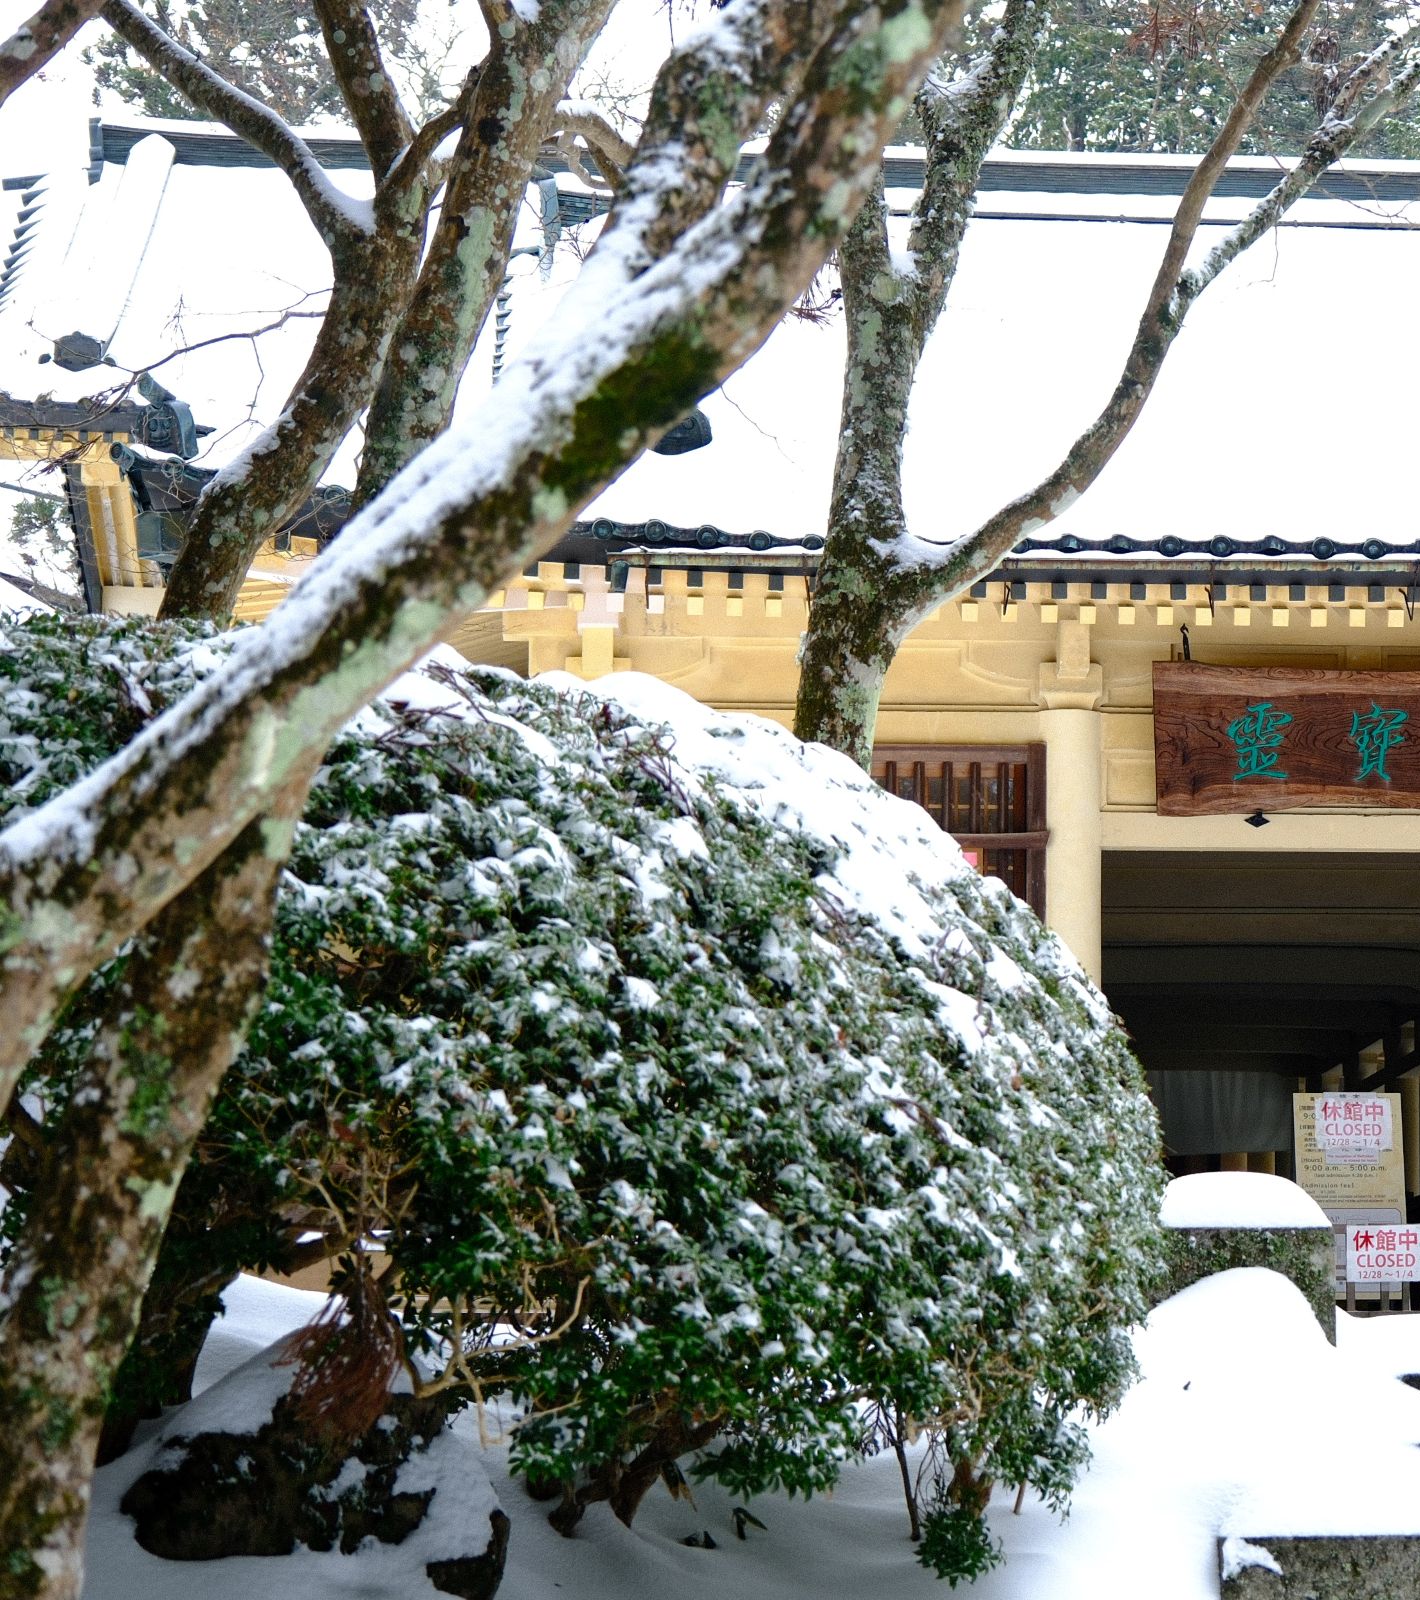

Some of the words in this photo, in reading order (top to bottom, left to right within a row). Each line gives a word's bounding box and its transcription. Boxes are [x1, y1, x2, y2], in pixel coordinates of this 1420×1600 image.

[1321, 1101, 1384, 1121] 休館中
[1325, 1123, 1383, 1136] CLOSED
[1327, 1138, 1350, 1146] 12/28
[1352, 1229, 1418, 1252] 休館中
[1356, 1253, 1416, 1268] CLOSED
[1358, 1271, 1382, 1279] 12/28
